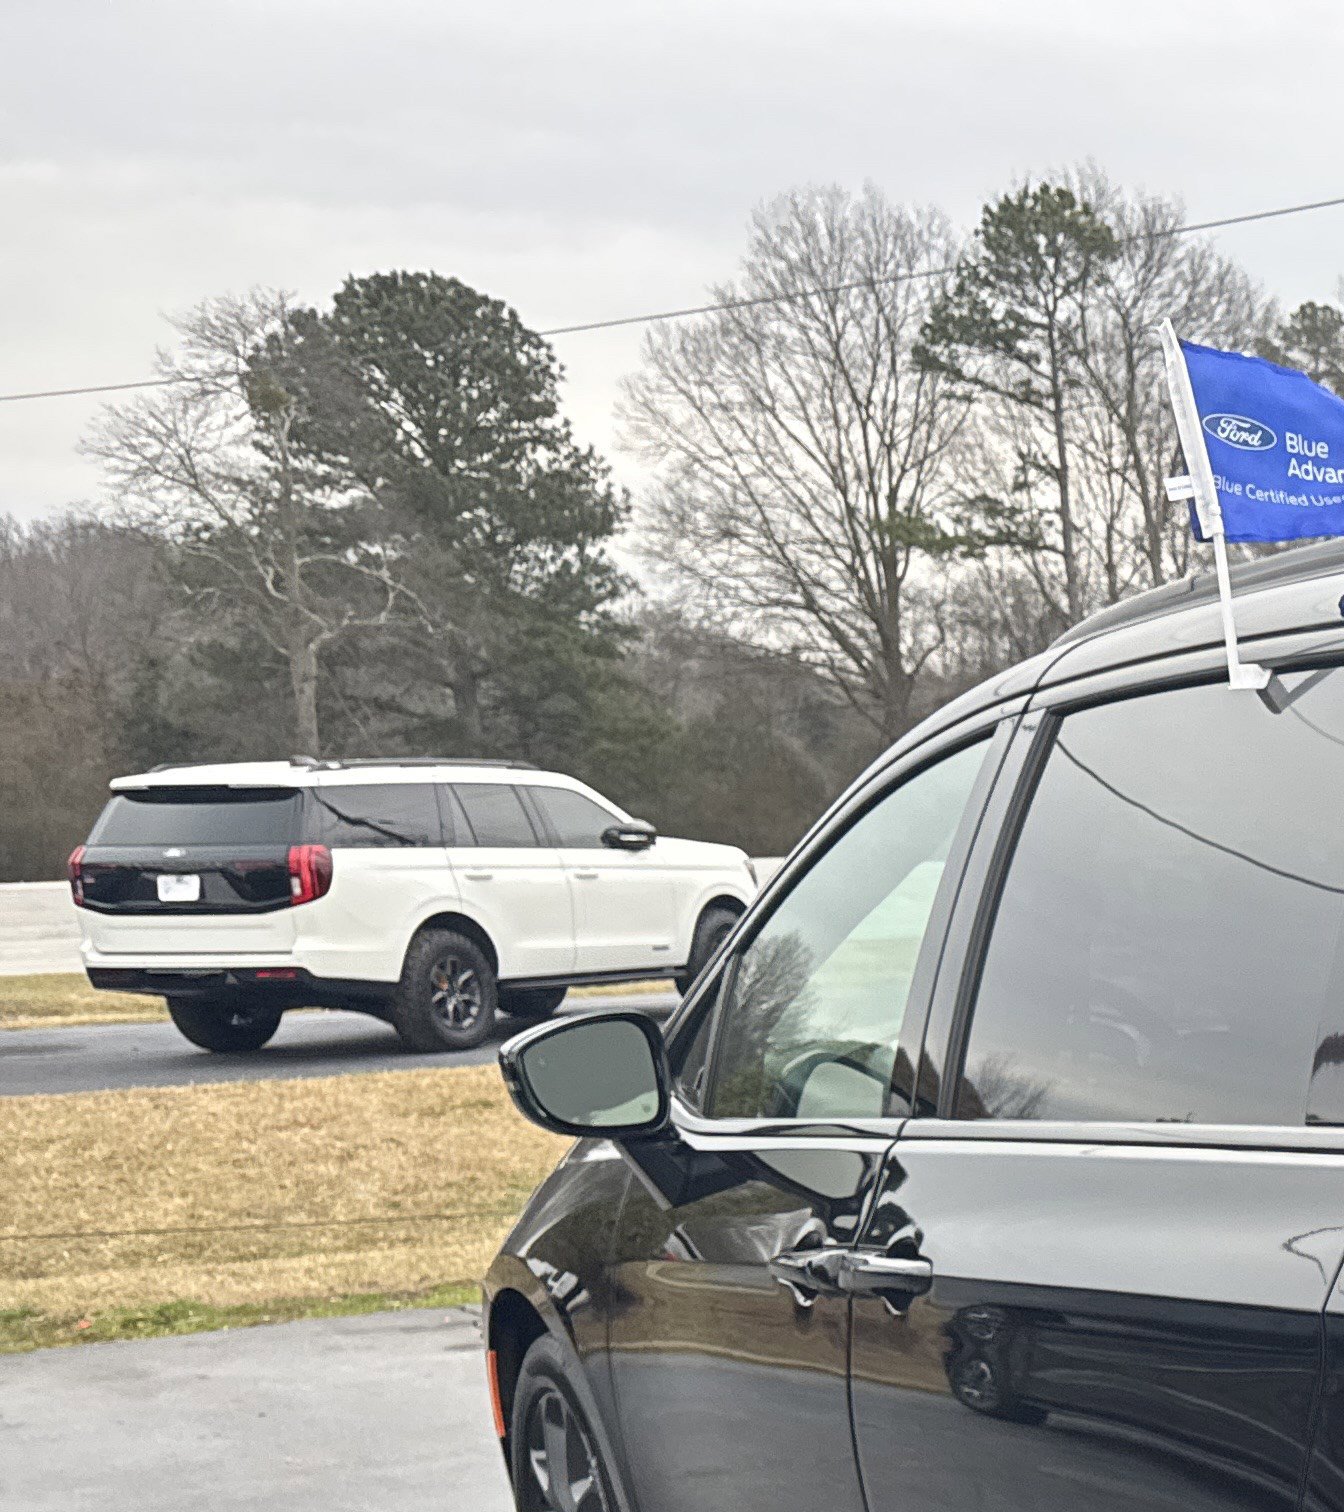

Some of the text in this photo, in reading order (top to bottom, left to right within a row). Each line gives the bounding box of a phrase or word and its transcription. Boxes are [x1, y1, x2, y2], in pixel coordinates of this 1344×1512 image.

[1216, 417, 1263, 447] Ford
[1285, 431, 1329, 458] Blue
[1245, 484, 1309, 507] Certified
